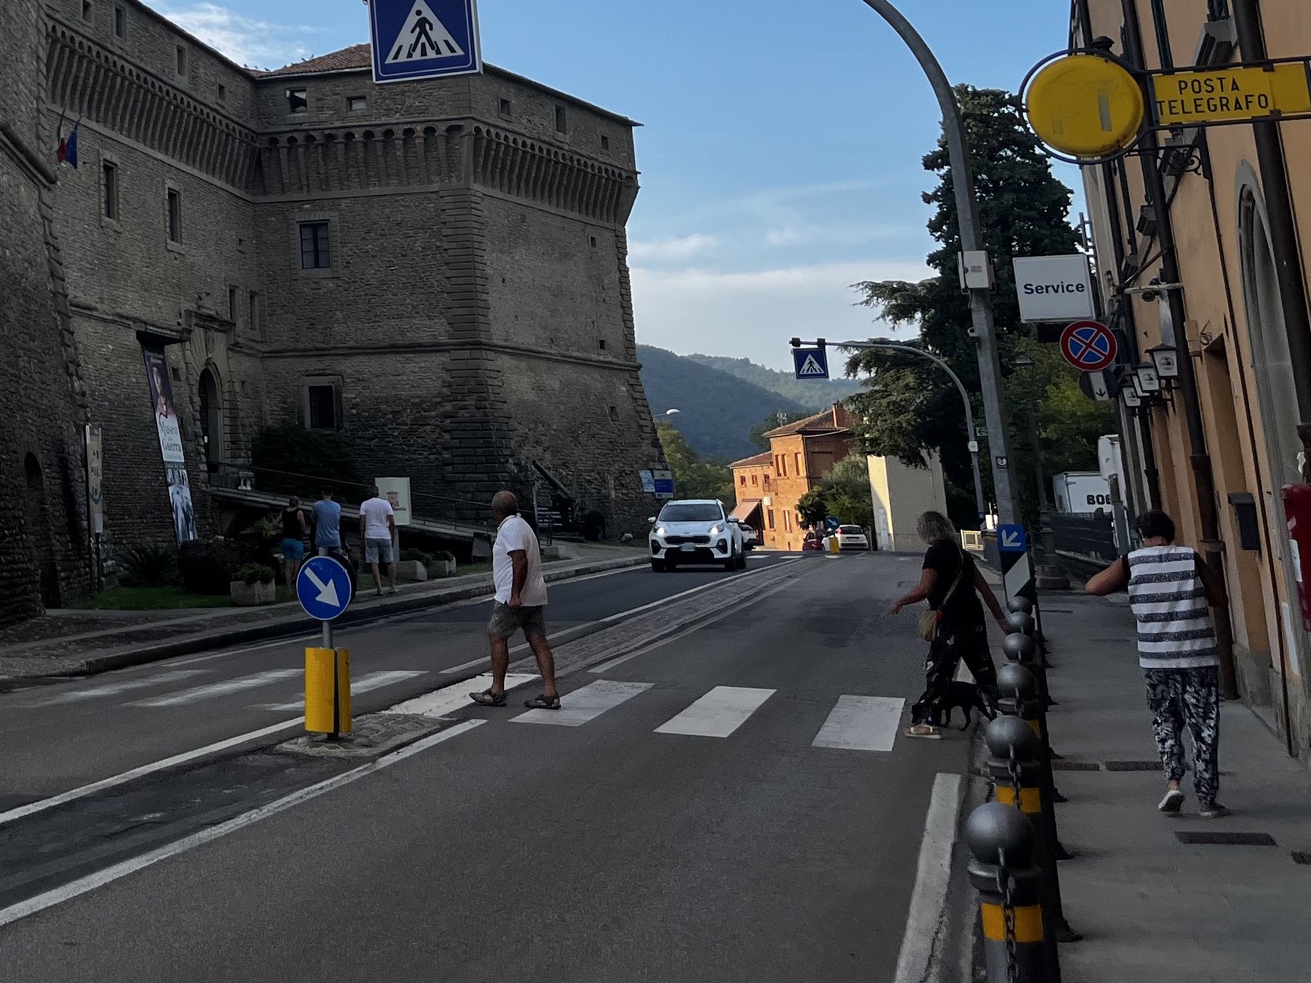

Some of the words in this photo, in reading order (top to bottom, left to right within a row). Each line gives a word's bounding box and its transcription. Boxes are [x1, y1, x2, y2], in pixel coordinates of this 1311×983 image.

[1178, 77, 1241, 95] POSTA
[1157, 94, 1269, 115] TELEGRAFO
[1024, 281, 1085, 294] Service
